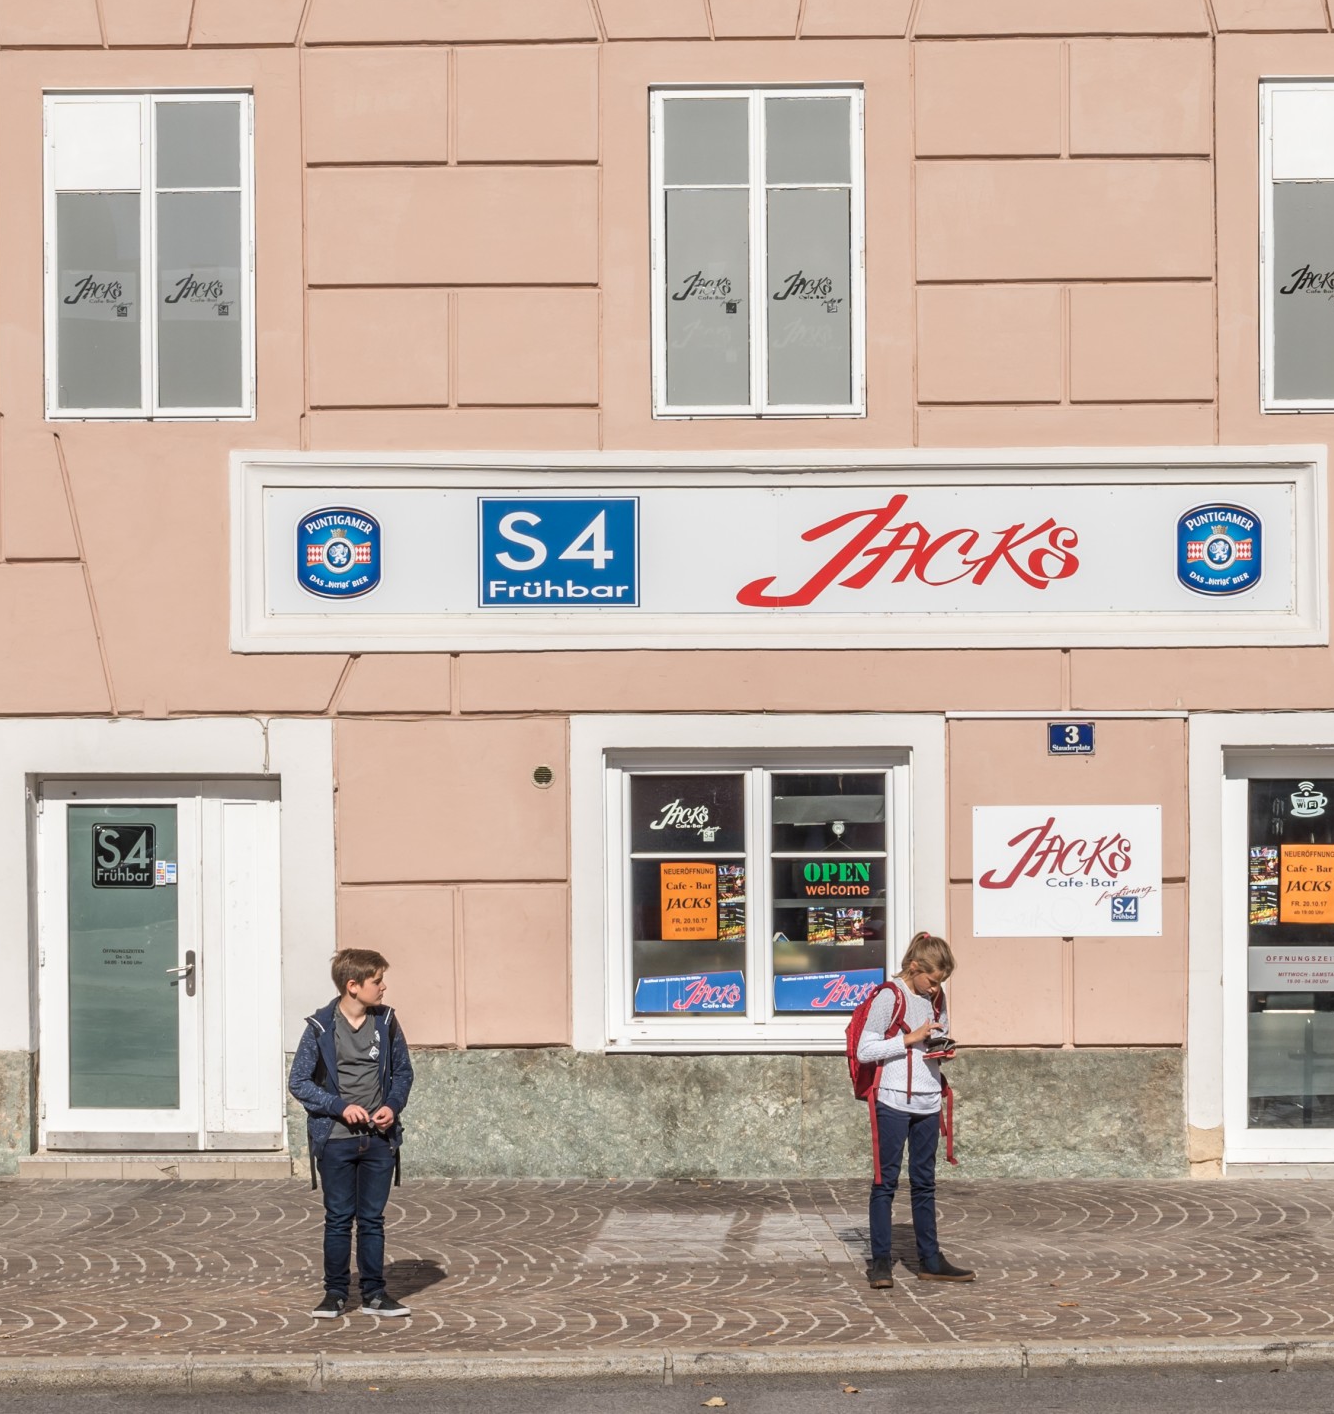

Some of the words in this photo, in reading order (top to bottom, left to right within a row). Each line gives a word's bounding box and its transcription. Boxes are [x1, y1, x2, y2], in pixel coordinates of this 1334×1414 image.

[63, 274, 122, 305] JACKS
[164, 273, 223, 304] JACKS
[305, 515, 373, 535] PUNTIGAMER
[1185, 511, 1254, 532] PUNTIGAMER
[736, 494, 1080, 608] JACKS
[309, 574, 325, 587] DAS
[351, 575, 369, 588] BIER
[1189, 571, 1204, 584] DAS
[1232, 572, 1250, 585] BIER
[489, 579, 628, 598] Frühbar
[1065, 725, 1080, 744] 3
[650, 798, 709, 830] JACKS
[96, 828, 151, 869] S4
[979, 817, 1132, 890] JACKS
[96, 867, 150, 882] Frühbar
[663, 867, 714, 875] NEUERÖFFNUNG
[803, 862, 871, 882] OPEN
[1286, 864, 1307, 873] Cafe
[1316, 864, 1333, 873] Bar
[666, 881, 687, 890] Cafe
[695, 881, 713, 890] Bar
[805, 882, 870, 896] welcome
[1286, 880, 1332, 893] JACKS
[665, 897, 713, 912] JACKS
[1112, 898, 1137, 915] S4
[672, 976, 740, 1009] JACKS
